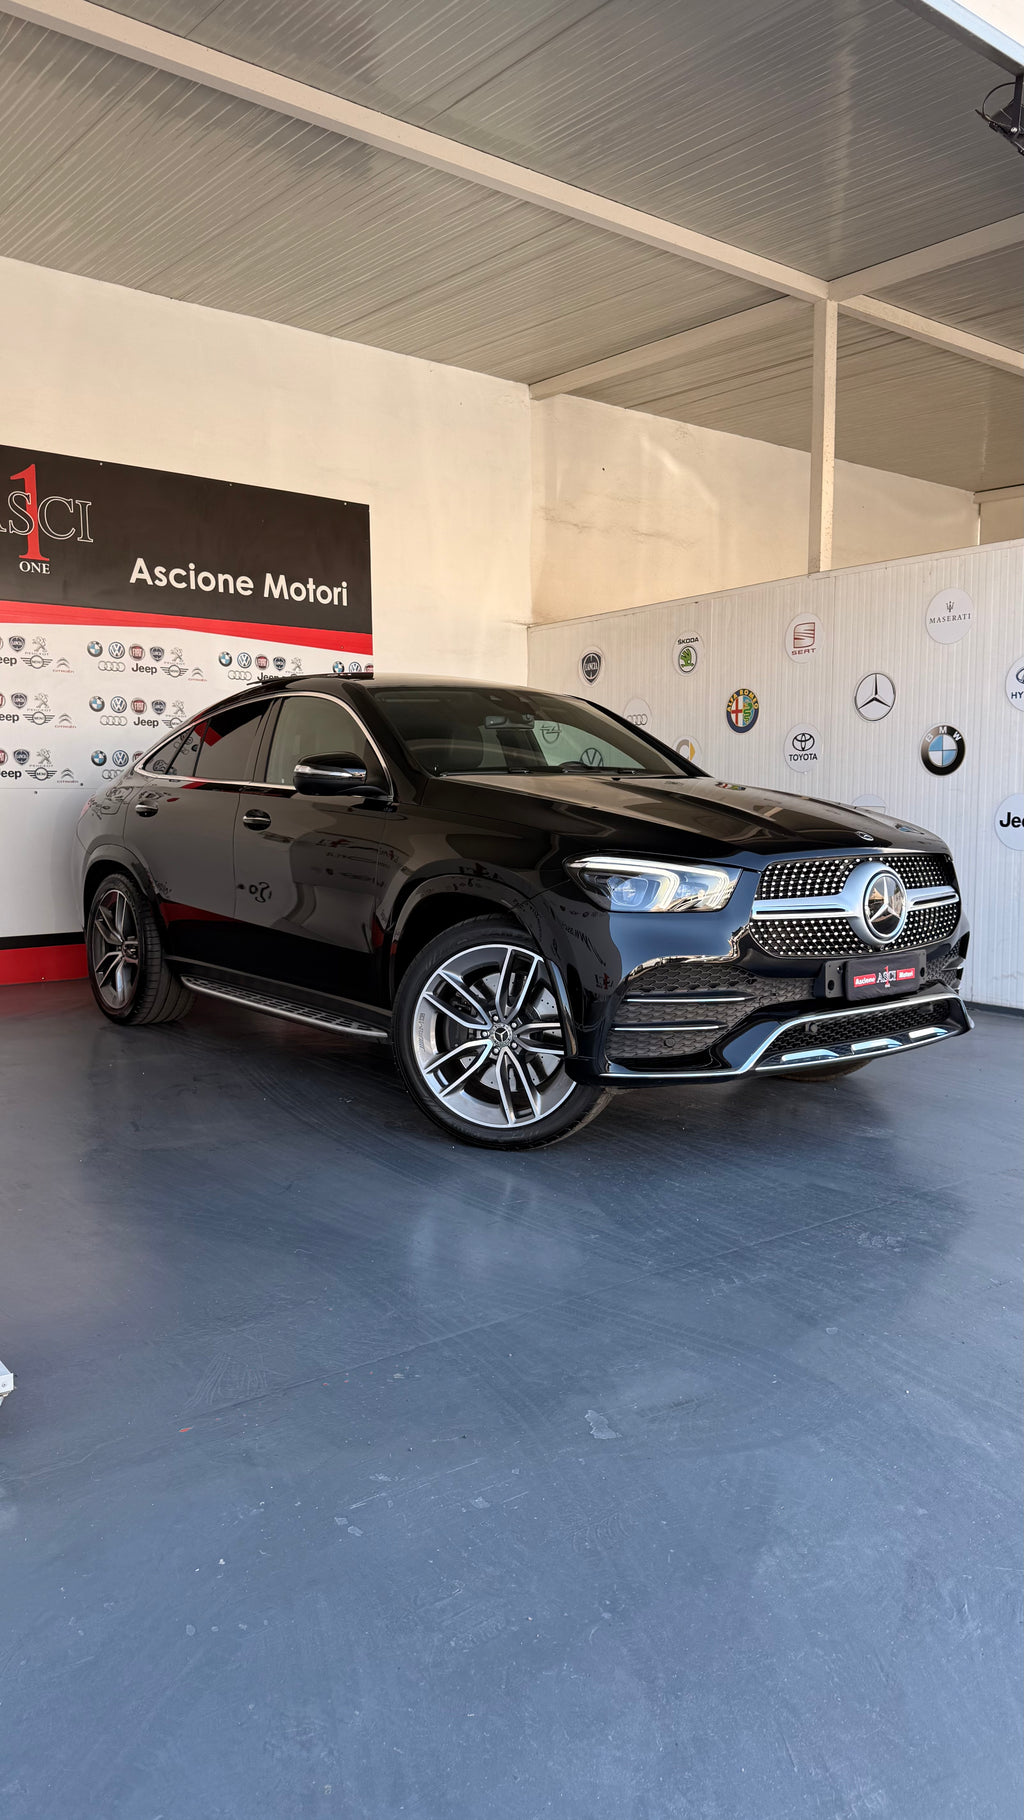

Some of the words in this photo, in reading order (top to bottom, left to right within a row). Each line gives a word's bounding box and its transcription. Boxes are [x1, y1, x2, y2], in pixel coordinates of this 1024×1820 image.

[19, 561, 51, 574] ONE
[129, 557, 254, 596] Ascione
[263, 573, 348, 607] Motori
[929, 613, 972, 624] MASERATI
[791, 648, 816, 656] SEAT
[131, 663, 158, 676] Jeep
[133, 717, 159, 728] Jeep
[925, 726, 962, 743] BMW
[788, 753, 818, 762] TOYOTA
[1000, 812, 1024, 828] Je
